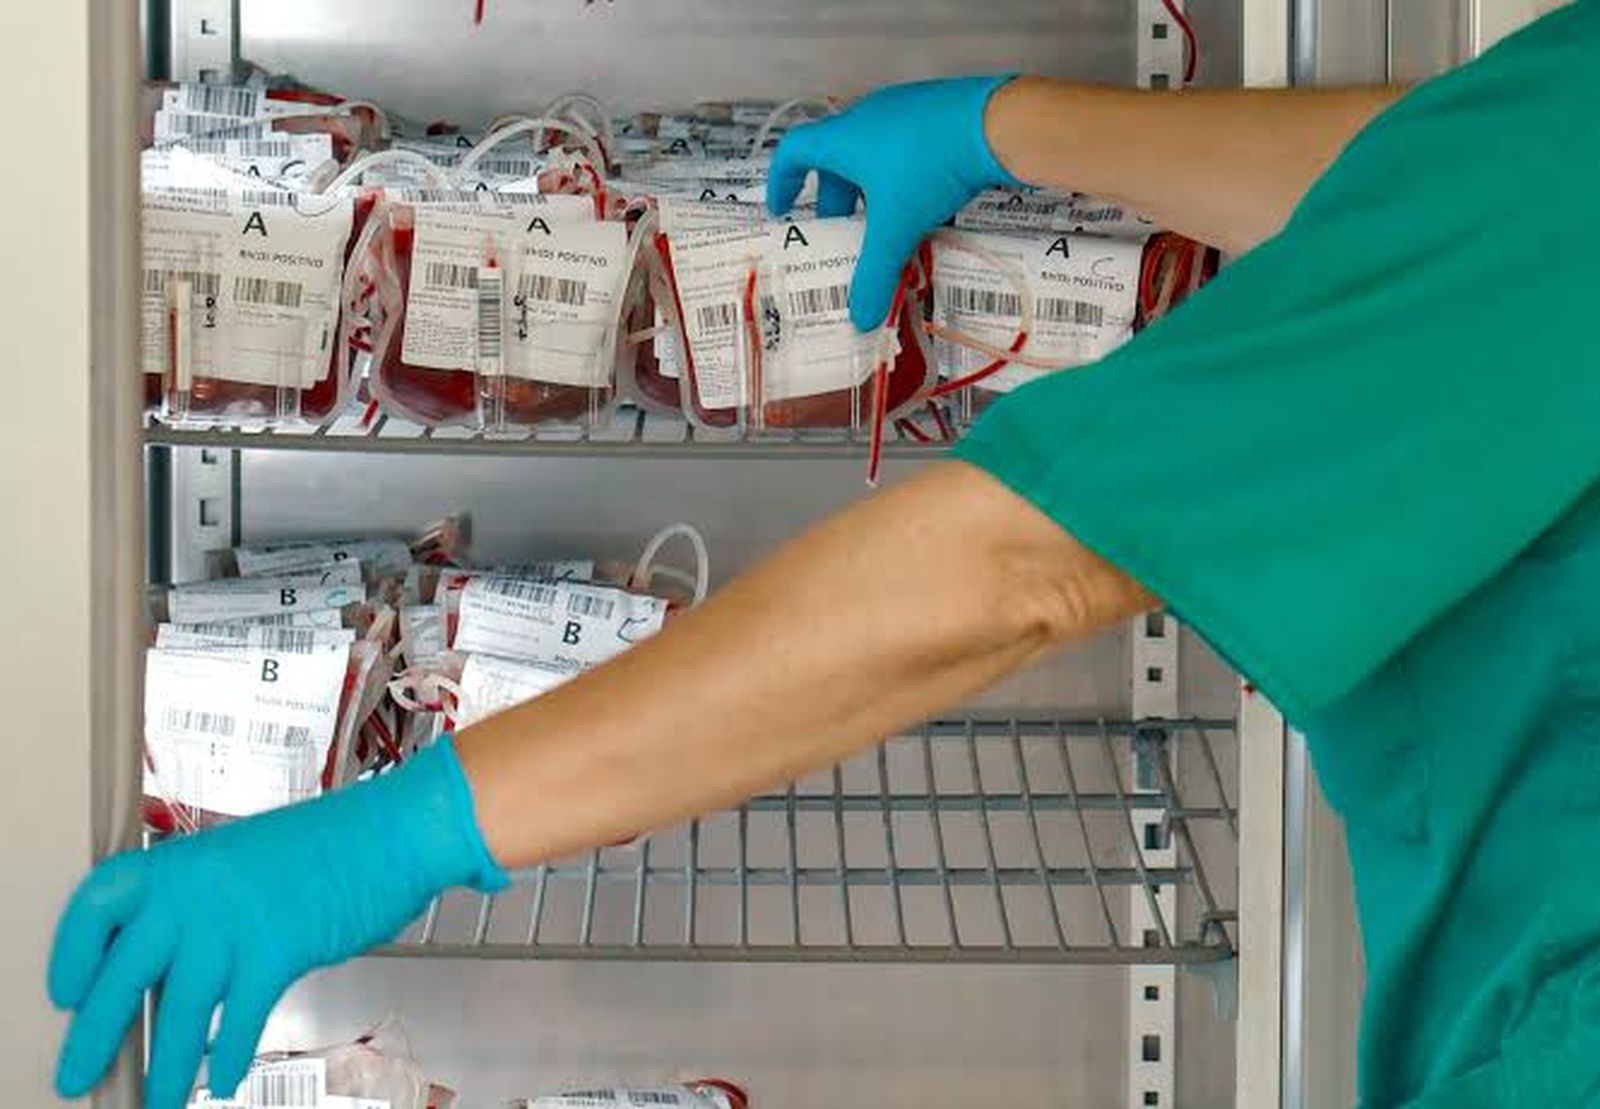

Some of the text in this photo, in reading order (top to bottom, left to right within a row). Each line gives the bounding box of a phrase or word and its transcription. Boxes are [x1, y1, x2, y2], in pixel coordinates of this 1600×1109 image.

[242, 211, 268, 237] A
[526, 216, 551, 235] A
[783, 225, 809, 250] A
[1045, 237, 1070, 259] A
[1073, 276, 1125, 292] POSITIVO
[279, 588, 298, 606] B
[562, 621, 582, 645] B
[260, 658, 279, 683] B
